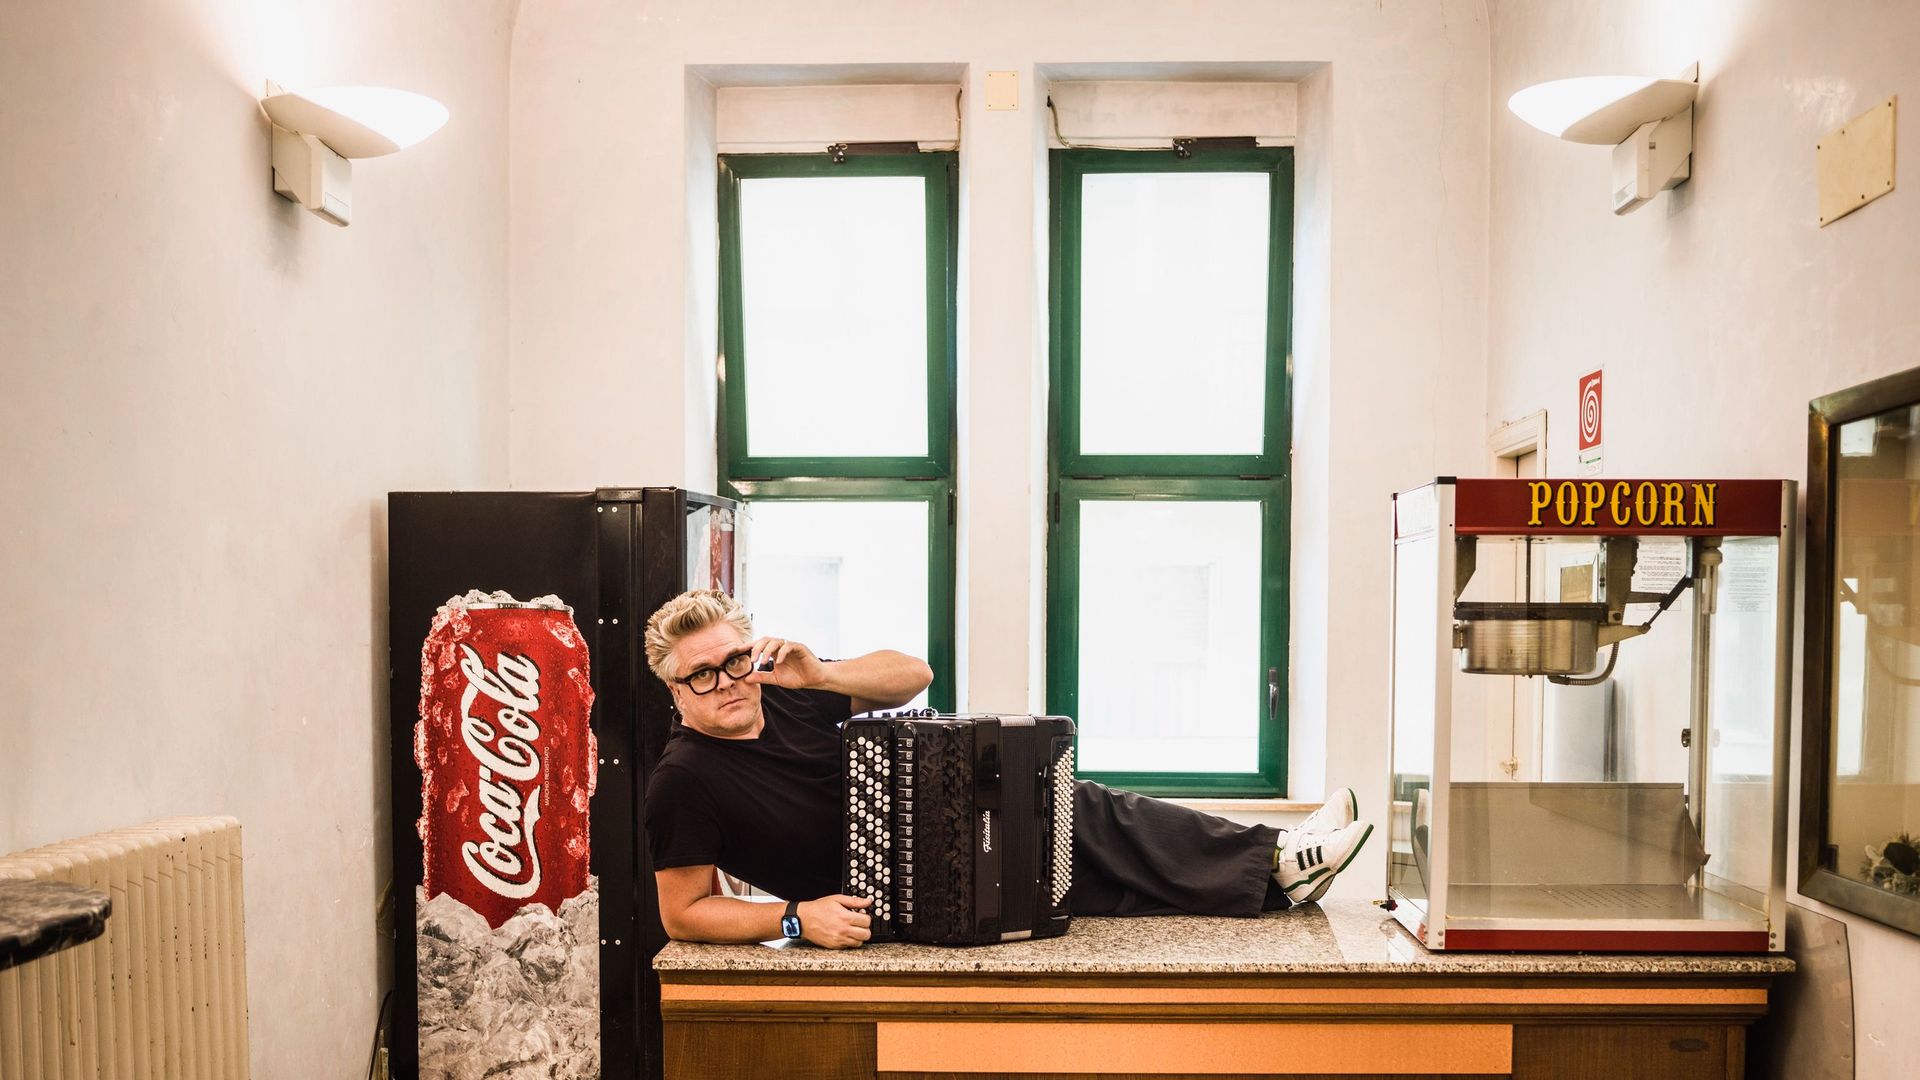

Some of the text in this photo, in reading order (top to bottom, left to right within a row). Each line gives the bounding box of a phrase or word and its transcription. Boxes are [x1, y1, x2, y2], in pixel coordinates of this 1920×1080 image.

[1528, 481, 1717, 526] POPCORN
[459, 643, 541, 899] Coca-Cola
[982, 810, 993, 853] Fisitalia
